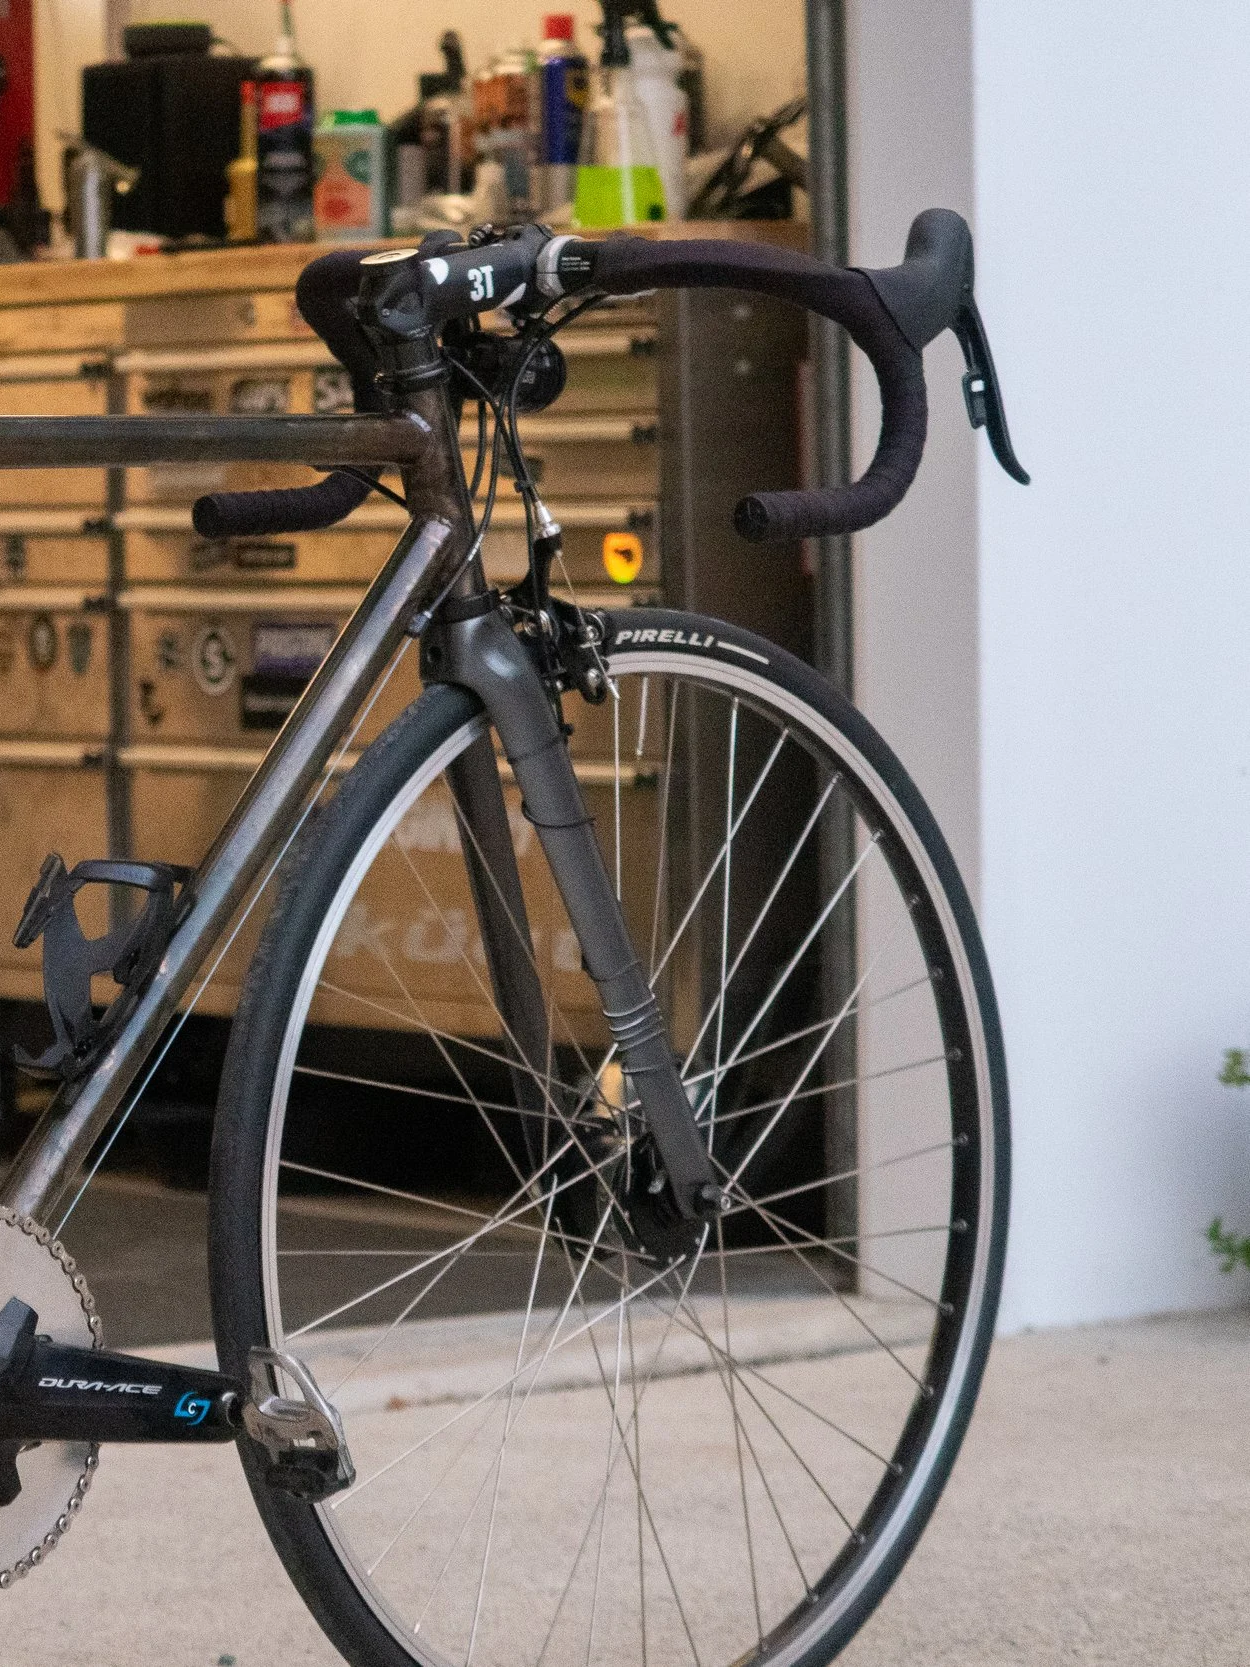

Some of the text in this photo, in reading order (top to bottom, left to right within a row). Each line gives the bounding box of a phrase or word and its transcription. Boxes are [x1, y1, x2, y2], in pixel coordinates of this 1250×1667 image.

[468, 265, 494, 301] 3T
[615, 629, 715, 648] PIRELLI
[38, 1377, 162, 1395] DURA-ACE
